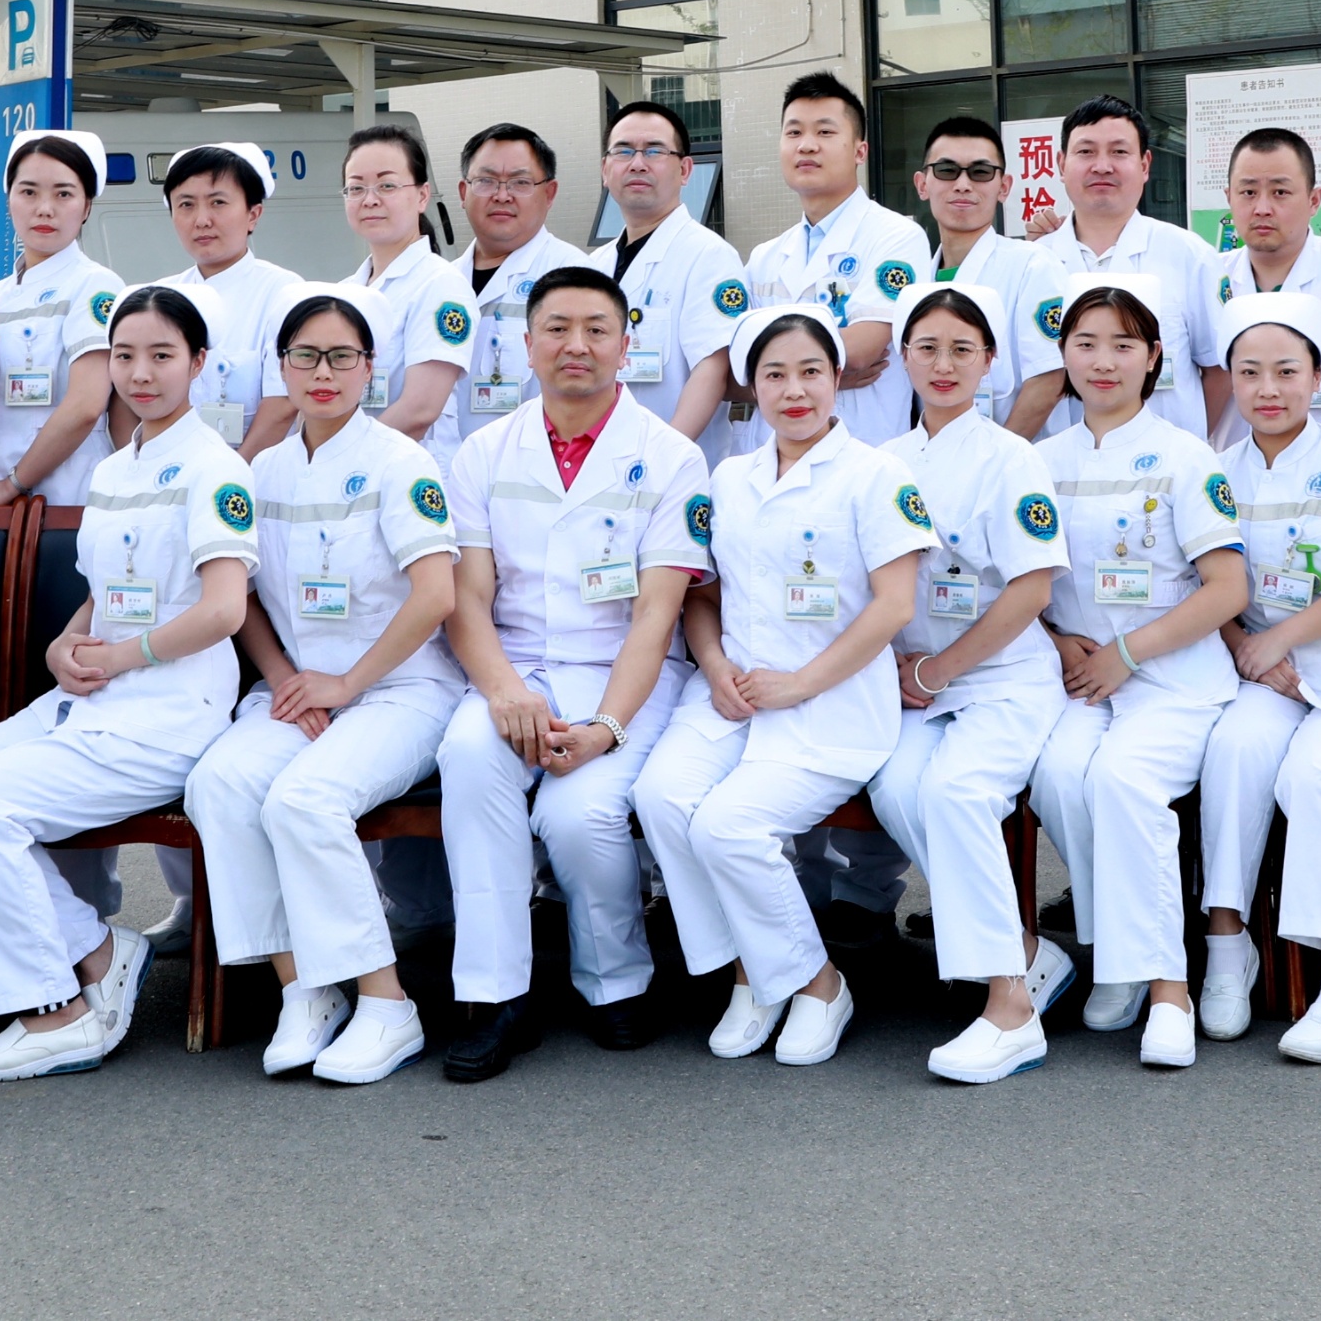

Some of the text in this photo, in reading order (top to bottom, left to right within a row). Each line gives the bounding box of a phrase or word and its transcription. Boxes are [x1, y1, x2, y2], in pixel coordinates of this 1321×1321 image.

[8, 0, 36, 71] P
[1240, 78, 1285, 92] 患者告知书
[2, 102, 36, 138] 120
